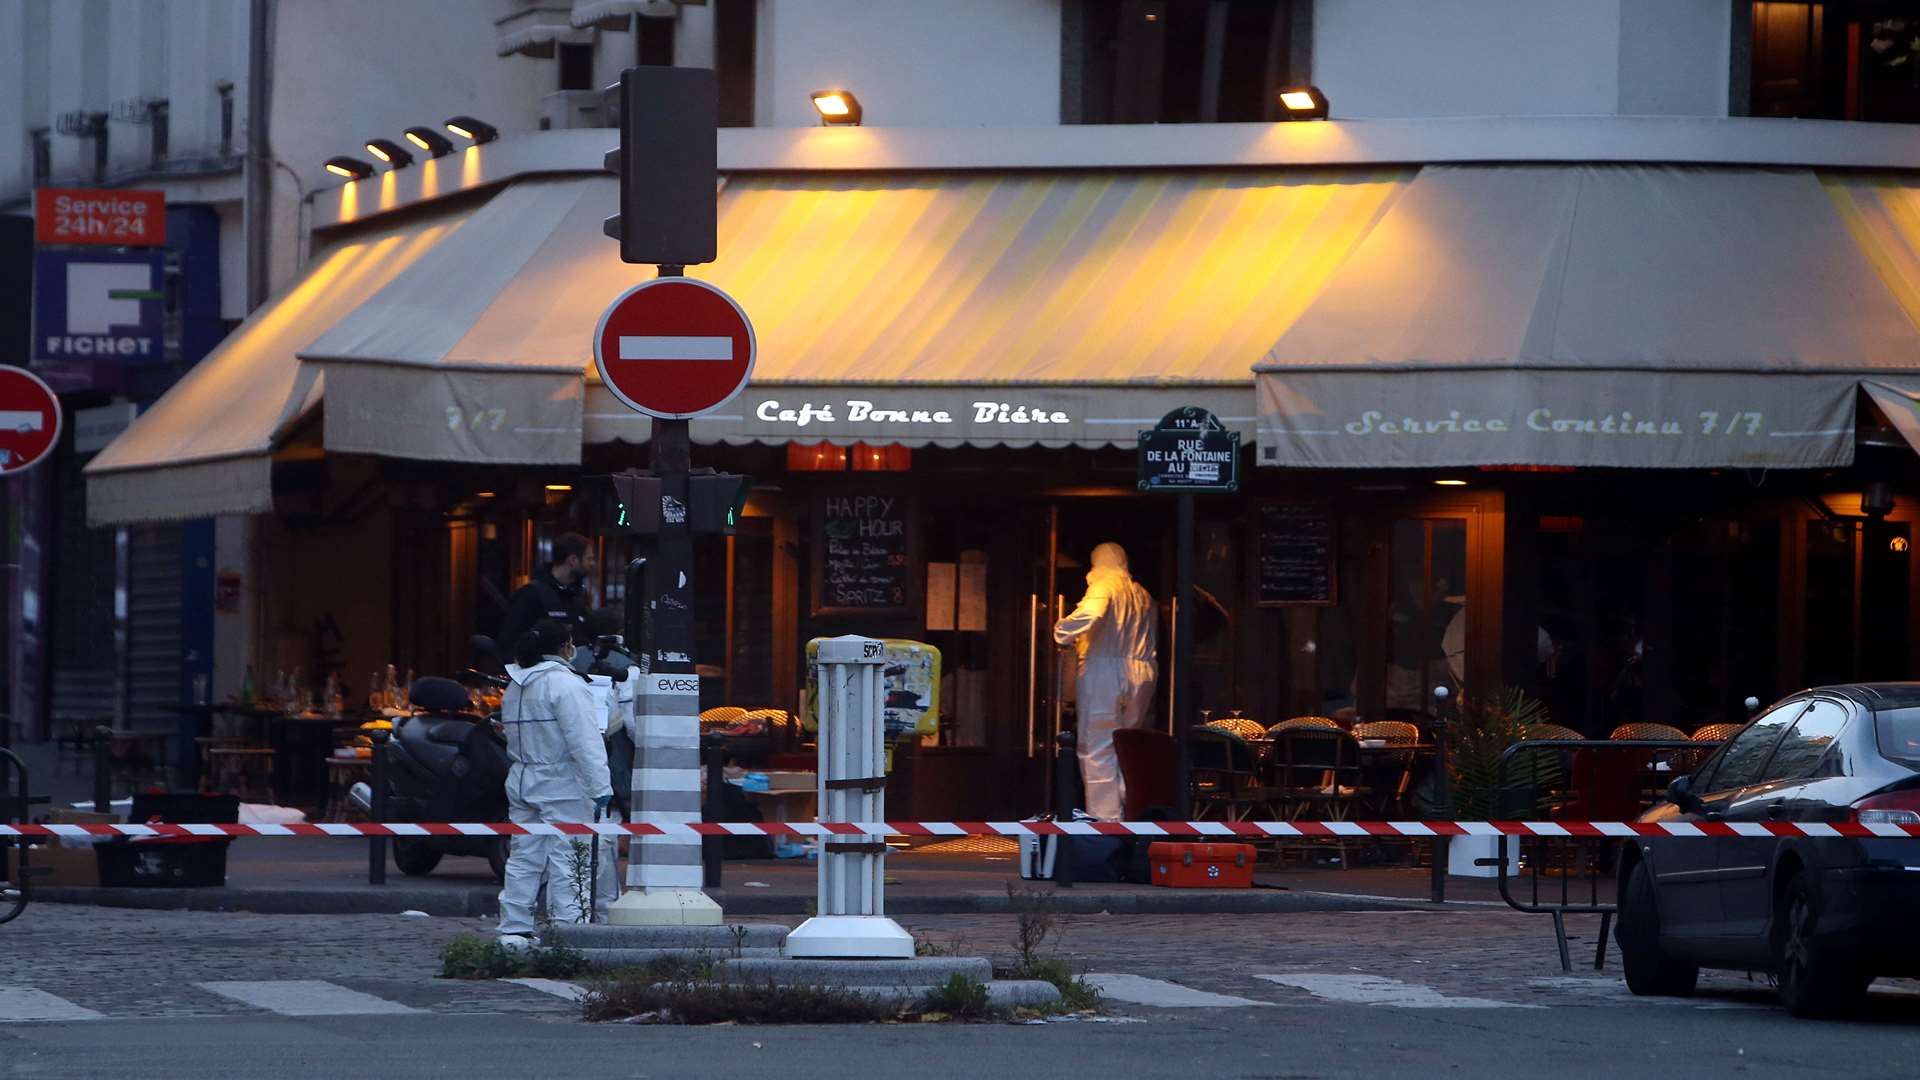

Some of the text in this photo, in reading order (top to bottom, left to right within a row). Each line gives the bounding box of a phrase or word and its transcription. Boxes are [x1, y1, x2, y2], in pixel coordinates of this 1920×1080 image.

[55, 195, 147, 215] Service
[55, 216, 145, 236] 24h/24
[756, 400, 836, 427] Café
[846, 400, 952, 423] Bonne
[1345, 408, 1763, 436] Service Continu 7/7
[1177, 439, 1203, 450] RUE
[1147, 451, 1231, 462] DE LA FONTAINE
[1168, 462, 1185, 473] AU
[826, 496, 895, 518] HAPPY
[859, 519, 904, 537] HOUR
